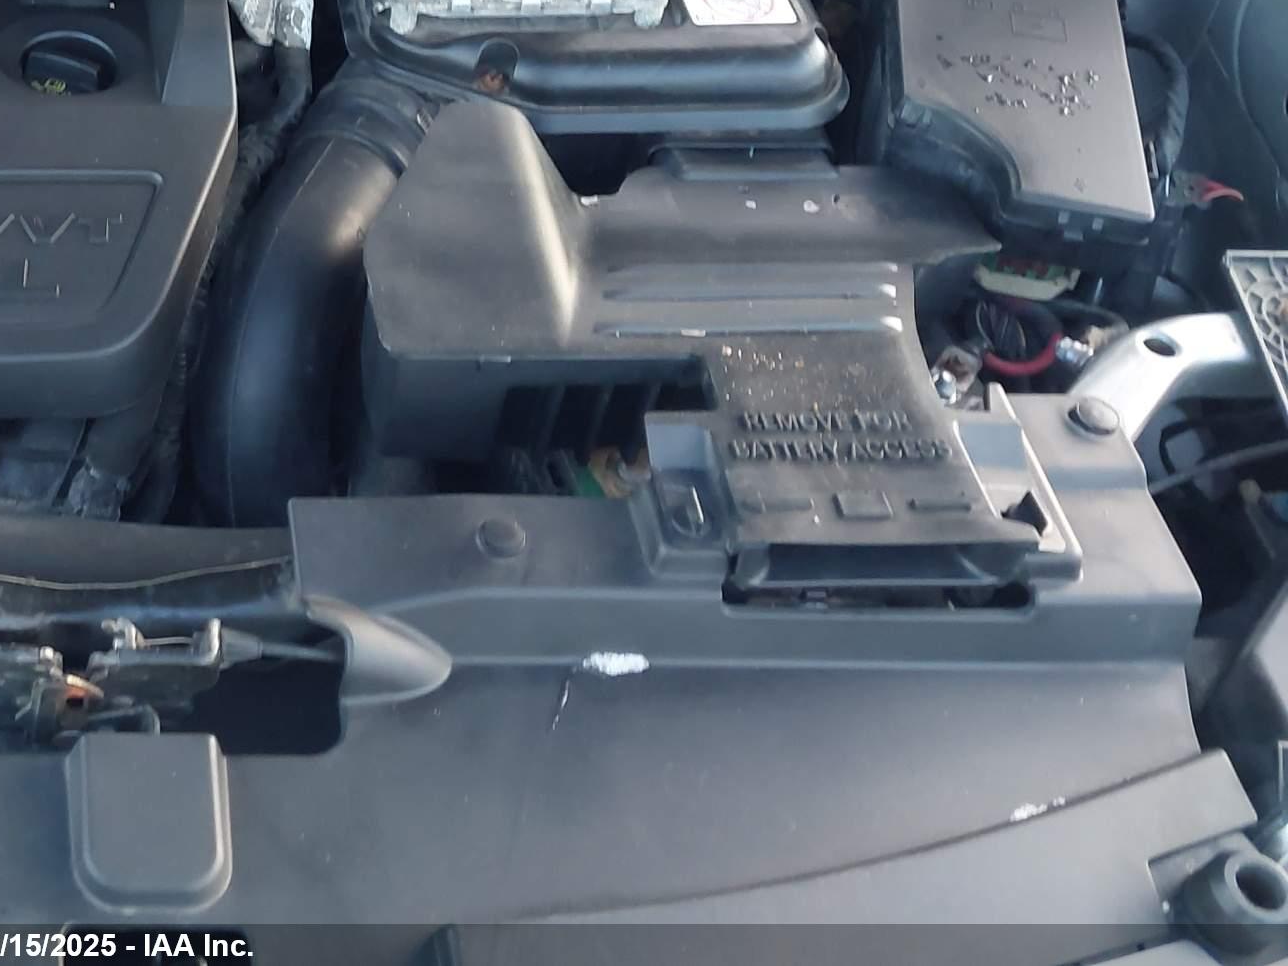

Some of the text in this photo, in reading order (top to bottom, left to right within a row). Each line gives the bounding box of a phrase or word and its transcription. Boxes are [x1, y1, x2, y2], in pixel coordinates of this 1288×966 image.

[742, 409, 913, 433] REMOVE FOR
[730, 438, 953, 462] BATTERY ACCESS
